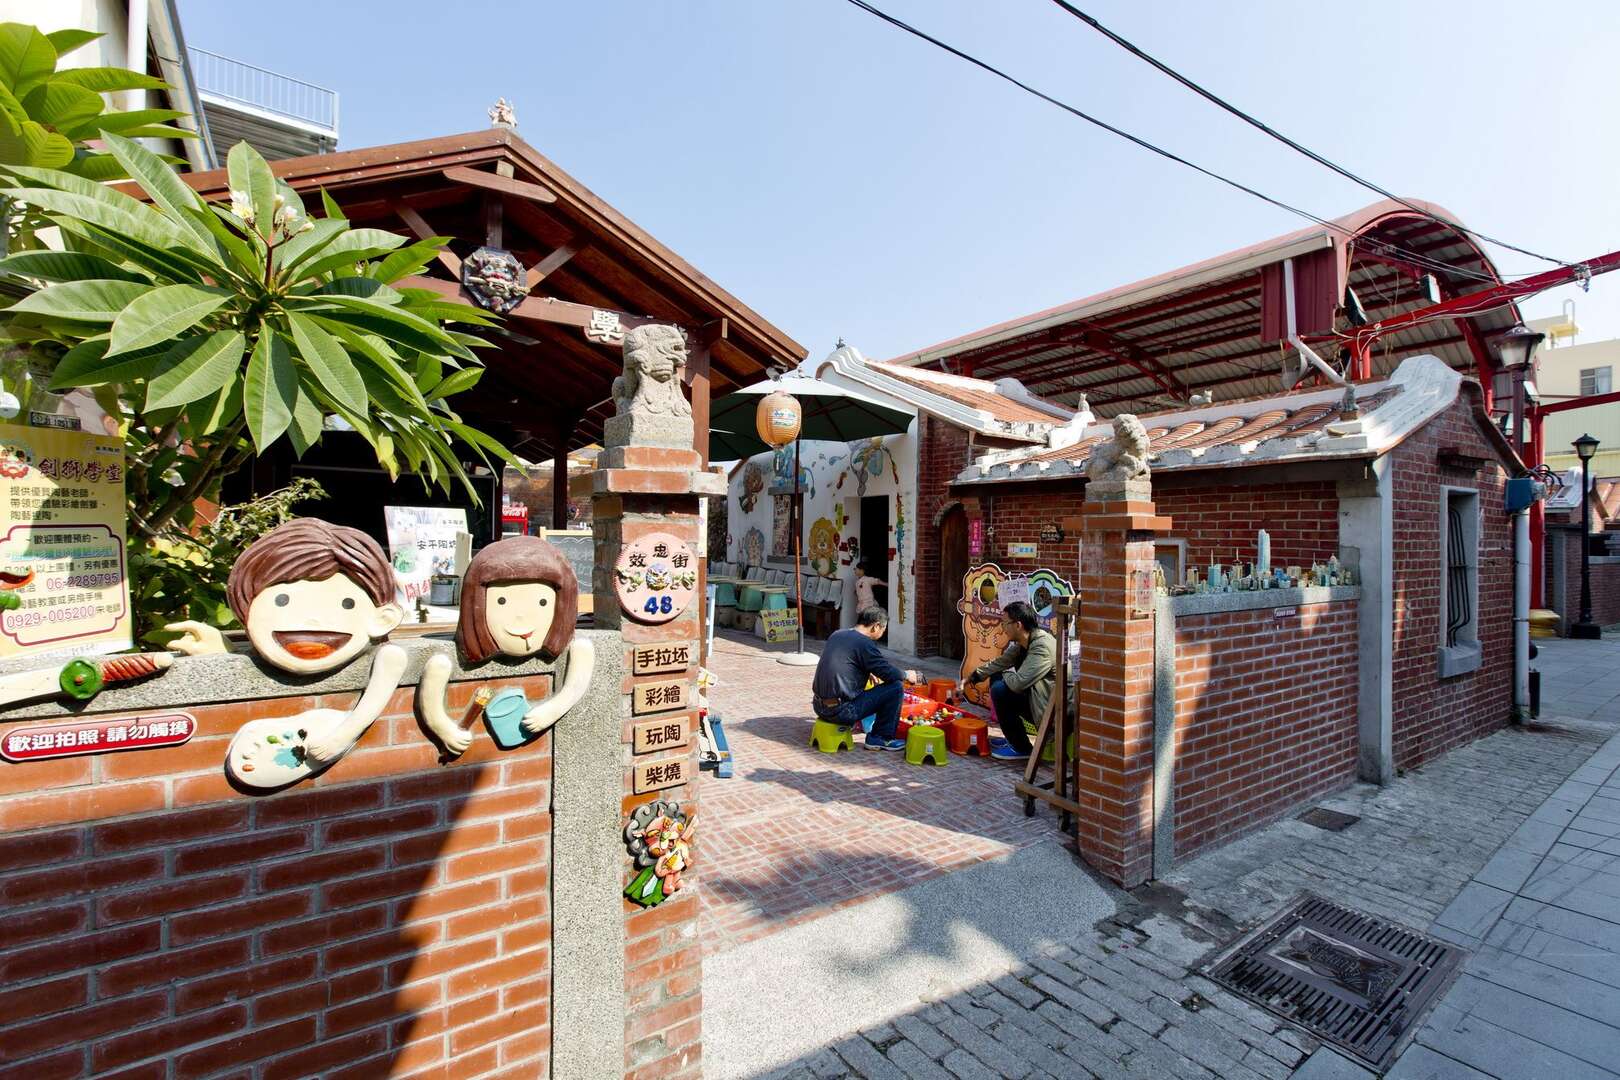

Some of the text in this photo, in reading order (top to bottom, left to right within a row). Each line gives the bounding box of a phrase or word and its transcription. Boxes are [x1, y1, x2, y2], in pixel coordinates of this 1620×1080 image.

[629, 543, 689, 568] 效忠街
[47, 572, 119, 590] 06-2289795
[643, 595, 673, 615] 48
[6, 605, 95, 628] 0929-005200
[637, 647, 688, 668] 手拉坯
[645, 685, 681, 706] 彩繪
[645, 724, 681, 745] 玩陶
[645, 762, 681, 785] 柴燒
